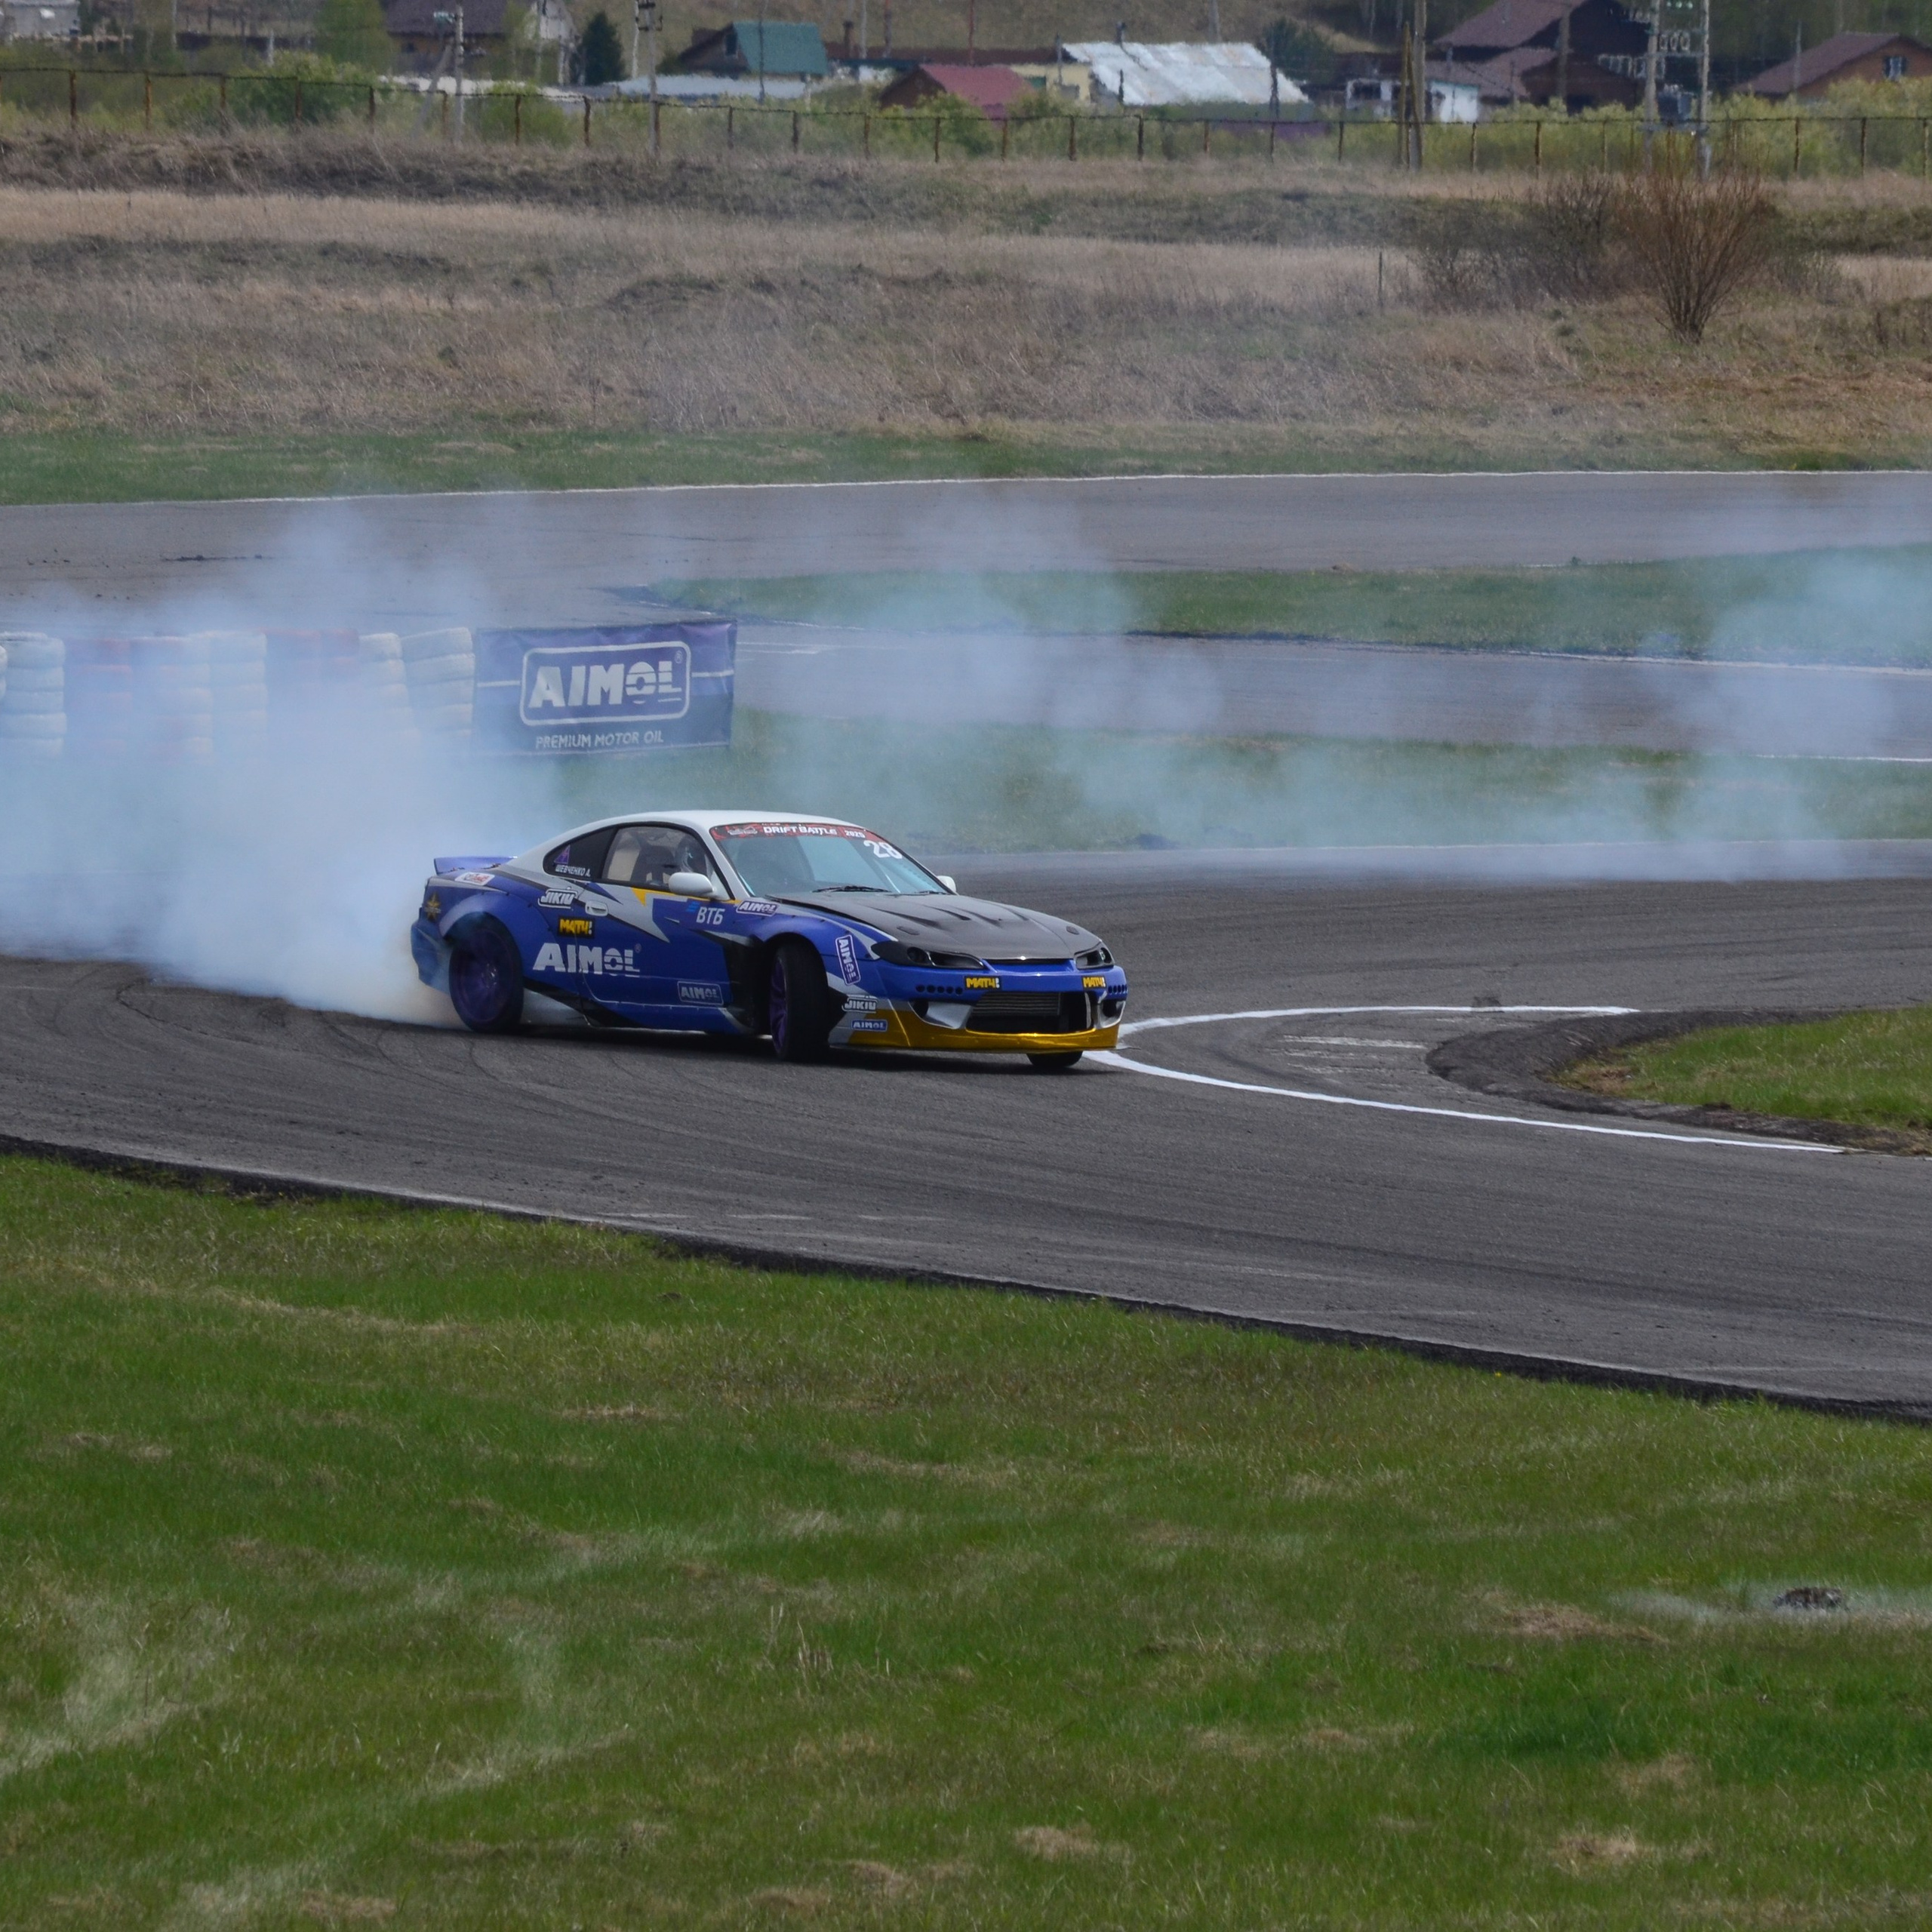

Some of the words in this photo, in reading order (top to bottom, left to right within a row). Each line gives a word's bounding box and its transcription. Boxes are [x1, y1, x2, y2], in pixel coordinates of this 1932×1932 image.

[528, 660, 682, 708] AIMOL
[535, 734, 592, 749] PREMIUM
[594, 731, 639, 747] MOTOR
[643, 730, 664, 744] OIL
[763, 826, 798, 834] DRIFT
[798, 825, 838, 835] BATTLE
[863, 839, 903, 860] 28
[540, 891, 575, 905] JIKIU
[739, 901, 777, 914] AIMOL
[696, 906, 725, 925] ВТБ
[533, 942, 640, 978] AIMOL
[838, 938, 857, 983] AIMOL
[681, 986, 720, 1000] AIMOL
[853, 1021, 885, 1030] AIMOL
